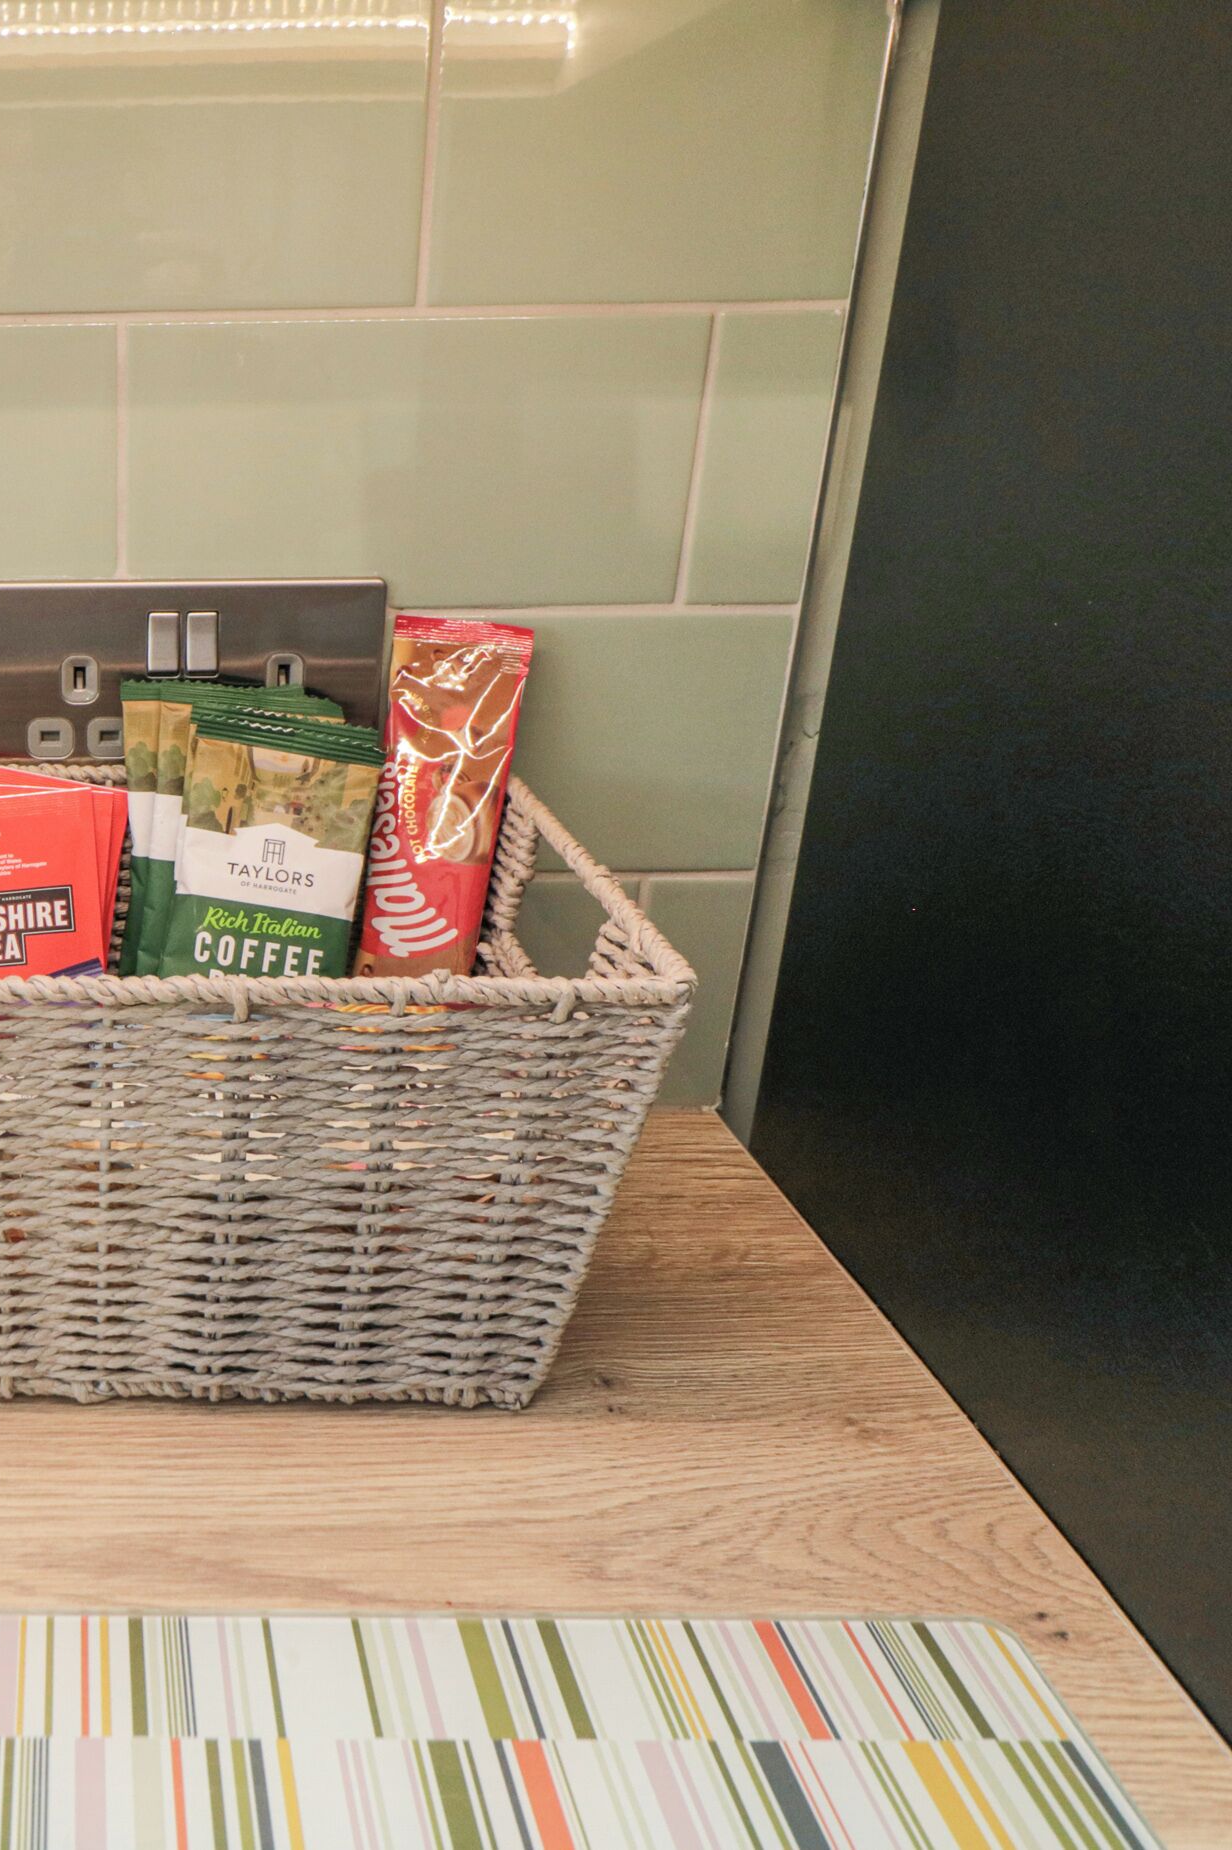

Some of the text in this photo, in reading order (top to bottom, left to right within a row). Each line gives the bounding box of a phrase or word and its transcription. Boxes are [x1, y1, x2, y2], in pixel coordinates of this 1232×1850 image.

[404, 764, 419, 836] CHOCOLATE
[227, 862, 315, 888] TAYLORS
[240, 880, 297, 896] OF HARROGATE
[203, 906, 323, 939] Rich Italian
[193, 930, 324, 977] COFFEE
